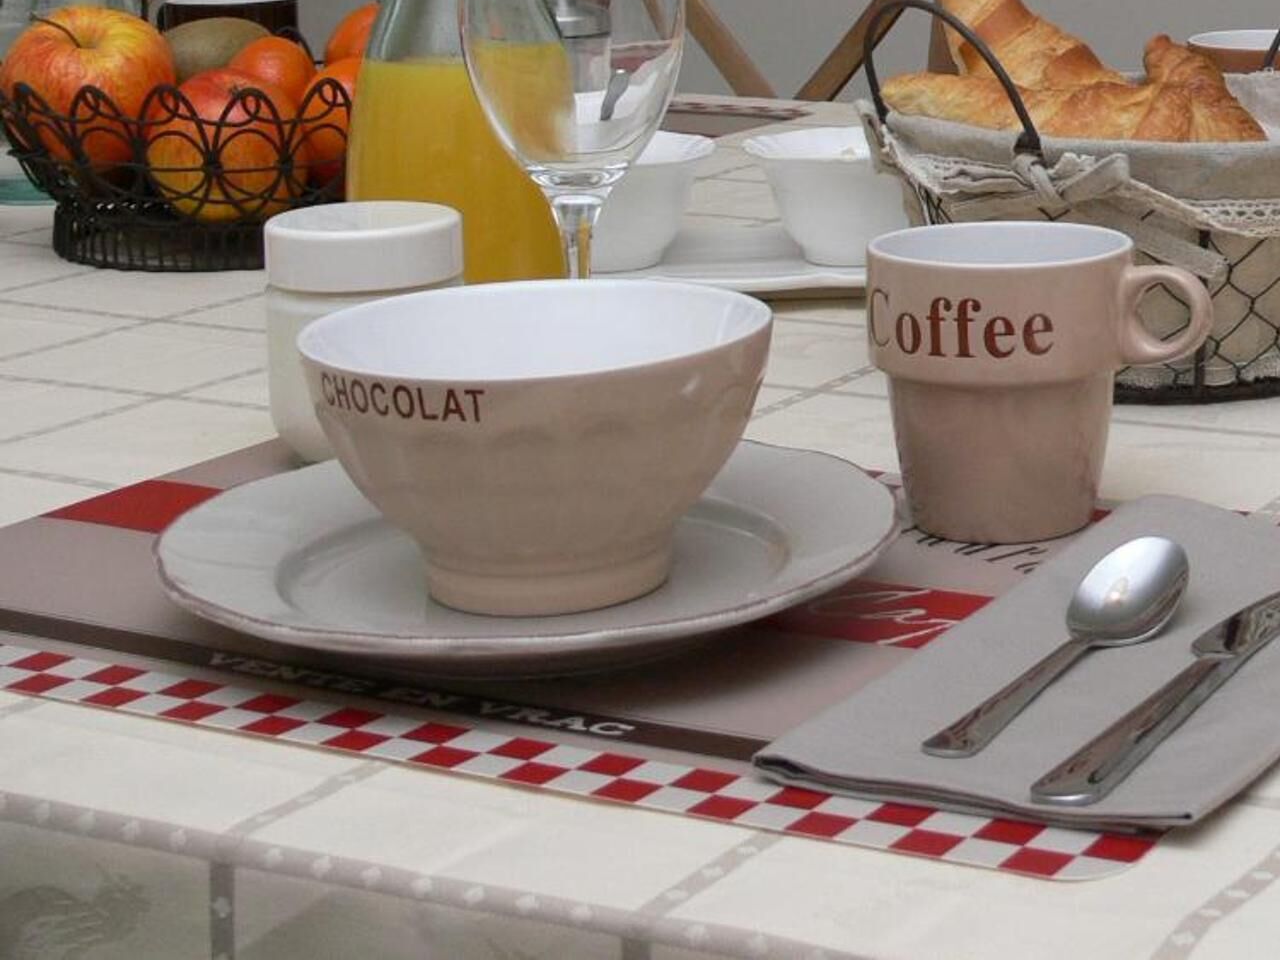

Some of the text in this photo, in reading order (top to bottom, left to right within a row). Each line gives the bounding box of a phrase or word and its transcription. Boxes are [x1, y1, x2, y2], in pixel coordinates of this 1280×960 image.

[868, 287, 1056, 359] Coffee
[320, 372, 486, 423] CHOCOLAT
[208, 651, 377, 695] VENTE
[478, 700, 637, 737] VRAC
